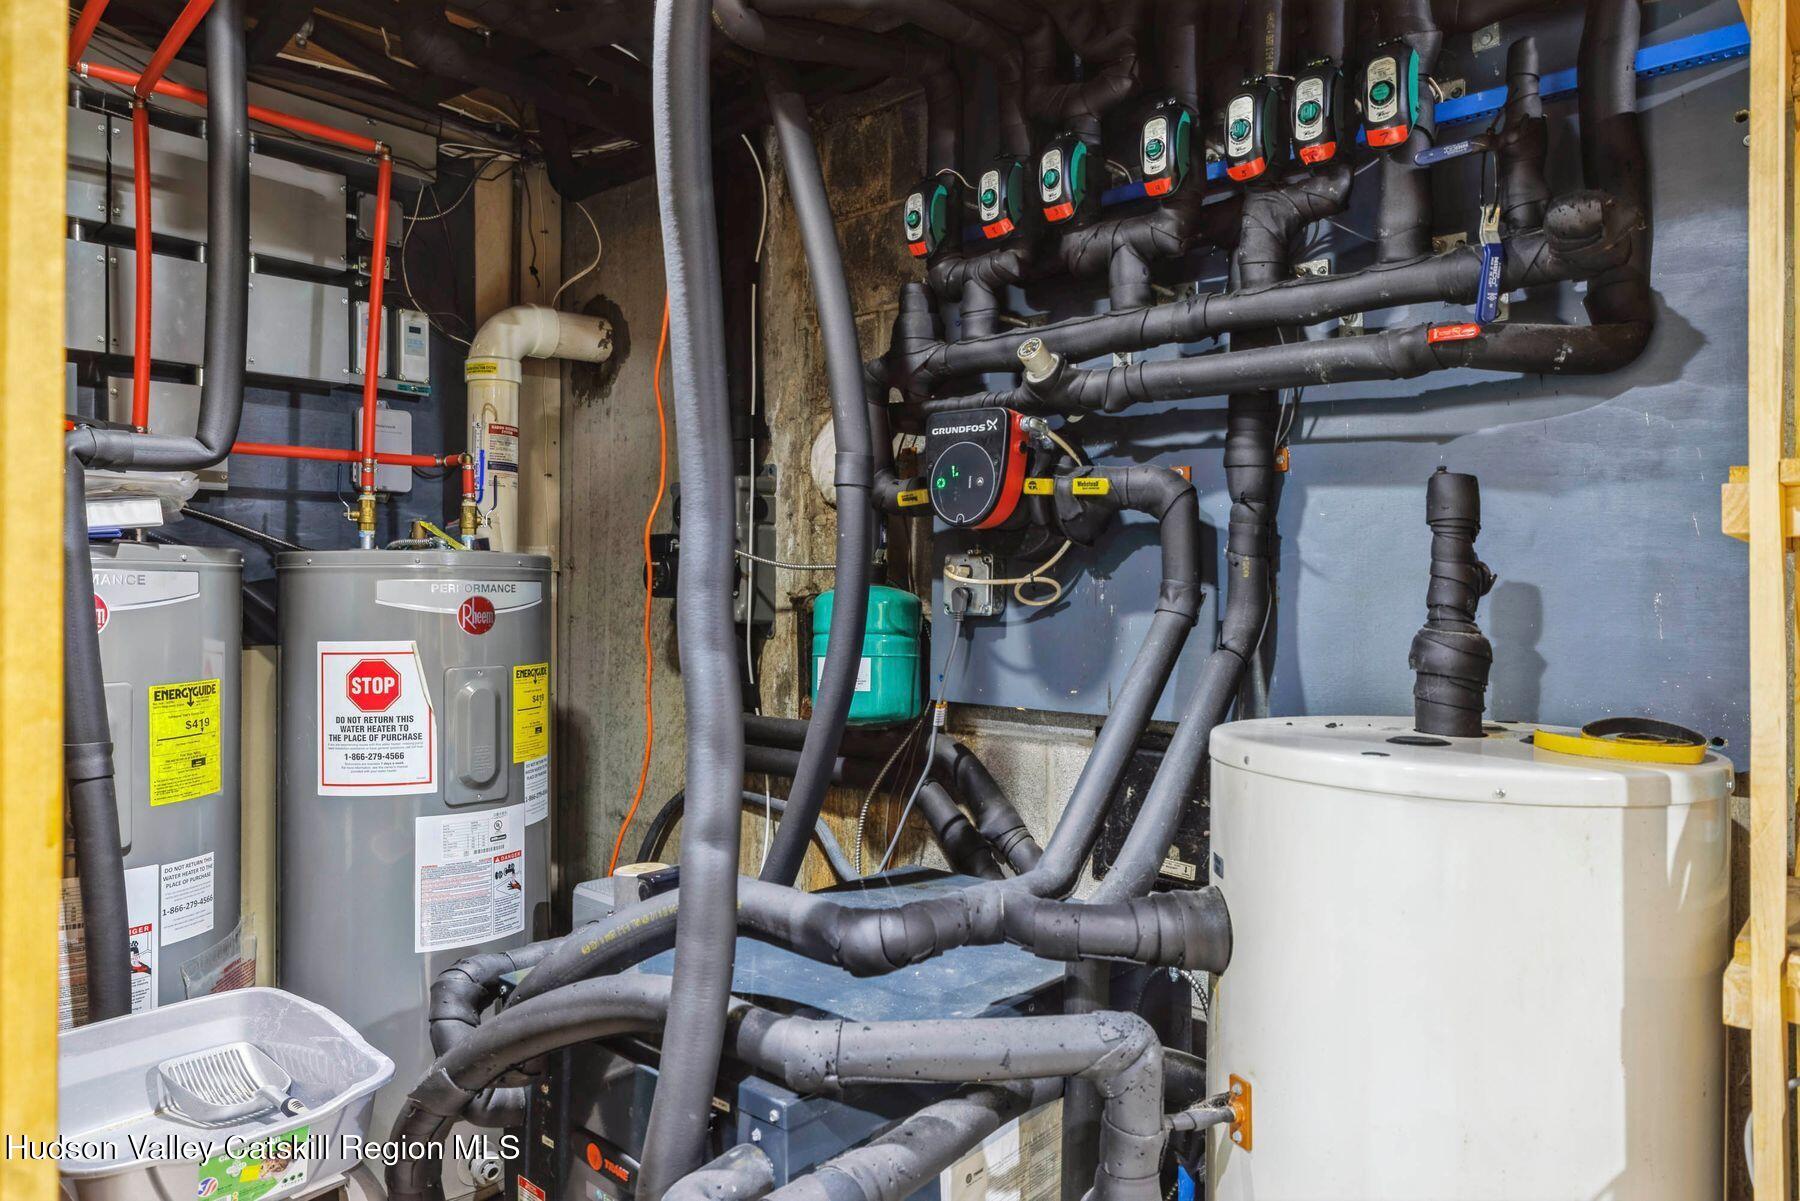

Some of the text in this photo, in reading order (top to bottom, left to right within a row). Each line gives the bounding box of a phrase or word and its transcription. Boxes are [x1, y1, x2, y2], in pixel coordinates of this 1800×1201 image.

[931, 424, 986, 436] GRUNDFOS
[461, 596, 494, 630] Rheem
[351, 676, 395, 695] STOP
[154, 683, 217, 702] ENERGYGUIDE
[185, 717, 210, 730] $419
[335, 715, 414, 724] DO NOT RETURN THIS
[340, 724, 409, 733] WATER HEATER TO
[328, 732, 423, 742] THE PLACE OF PURCHASE
[344, 752, 405, 761] 1-866-279-4566
[185, 860, 204, 869] RETURN
[162, 873, 182, 882] WATER
[181, 868, 199, 877] HEATER
[165, 881, 182, 889] PLACE
[189, 871, 211, 882] PURCHASE
[162, 894, 214, 916] 1-866-279-4566
